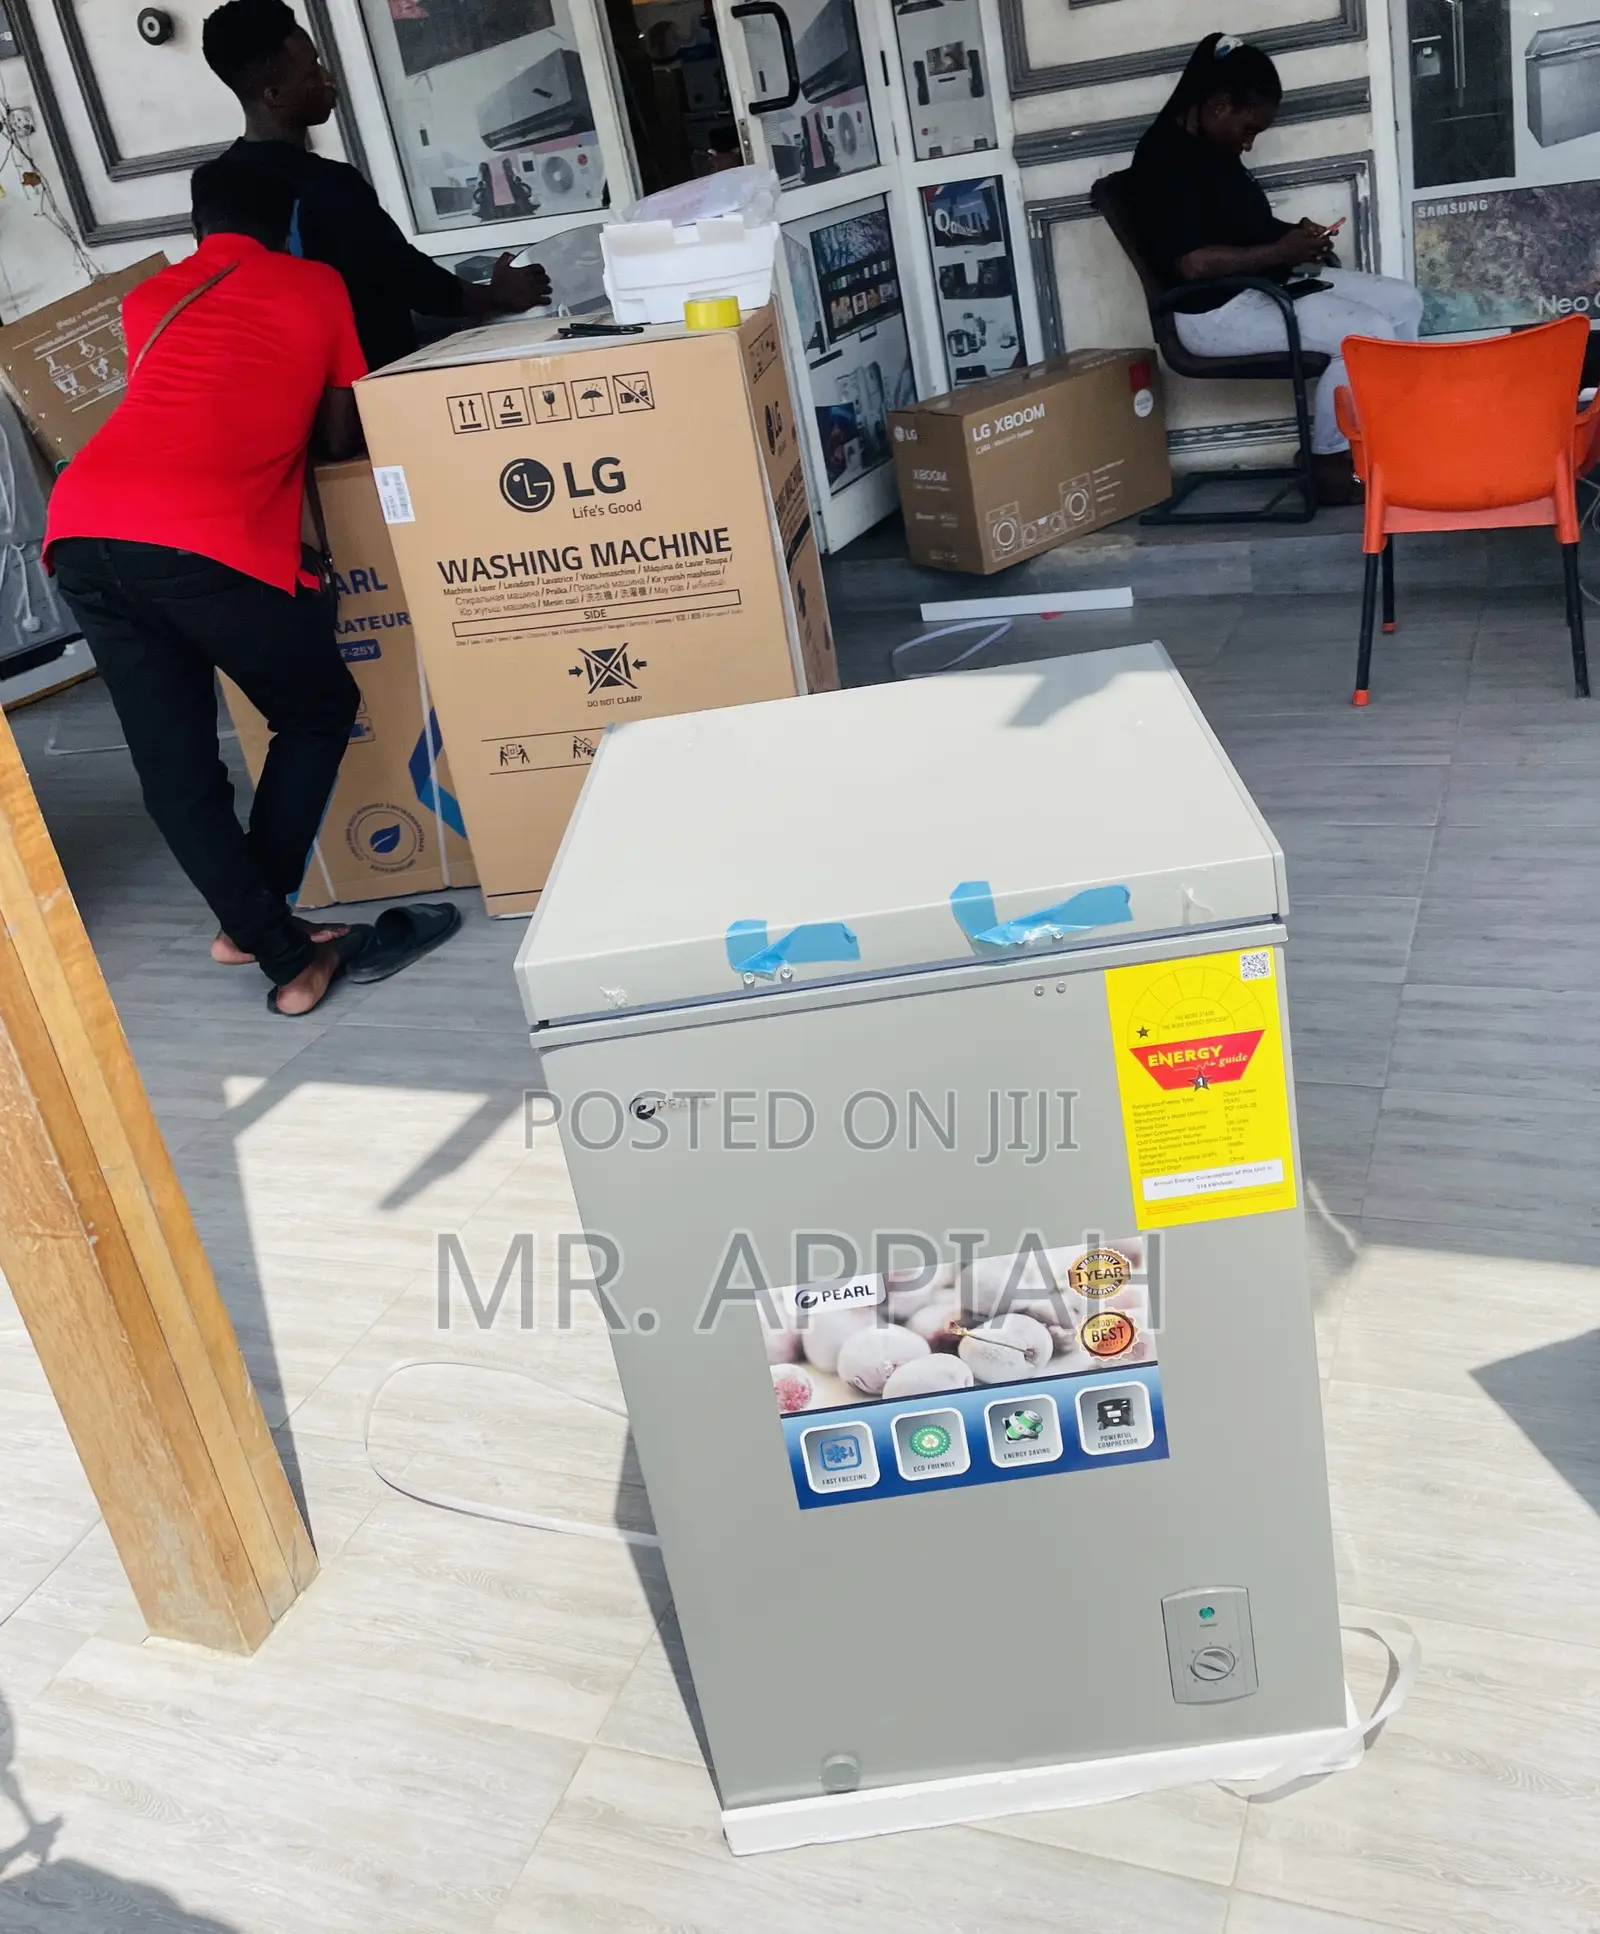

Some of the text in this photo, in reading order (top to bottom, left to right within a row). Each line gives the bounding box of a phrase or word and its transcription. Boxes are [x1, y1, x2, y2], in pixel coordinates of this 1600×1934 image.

[1417, 199, 1488, 218] SAMSUNG
[1537, 294, 1590, 315] Neo
[502, 395, 514, 410] 4
[971, 423, 991, 442] LG
[994, 403, 1045, 434] XBOOM
[904, 429, 918, 440] LG
[563, 456, 627, 498] LG
[572, 500, 642, 519] Life's Good
[437, 526, 733, 585] WASHING MACHINE
[331, 566, 389, 597] ARL
[443, 588, 473, 596] Machine
[503, 580, 536, 590] Lavadora
[541, 575, 574, 585] Lavatrice
[580, 568, 636, 581] Waschmaschine
[643, 564, 674, 574] Máquina
[684, 559, 704, 568] Lavar
[705, 556, 729, 566] Roupa
[583, 608, 607, 621] SIDE
[335, 611, 413, 635] RATEUR
[340, 645, 377, 658] F-25Y
[587, 695, 643, 708] DO NOT CLAMP
[1147, 1045, 1224, 1068] ENERGY
[1218, 1053, 1248, 1068] guide
[1197, 1077, 1204, 1086] 1
[1079, 1254, 1119, 1269] WARRANTY
[1084, 1266, 1124, 1281] YEAR
[822, 1284, 875, 1303] PEARL
[1081, 1281, 1120, 1295] WARRANTY
[1091, 1326, 1125, 1343] BEST
[1097, 1438, 1138, 1449] COMPRESSOR
[1100, 1432, 1132, 1442] POWERFUL
[1003, 1448, 1051, 1460] ENERGY SAVING
[913, 1461, 956, 1473] ECO FRIENDLY
[822, 1474, 868, 1486] FAST FREEZING
